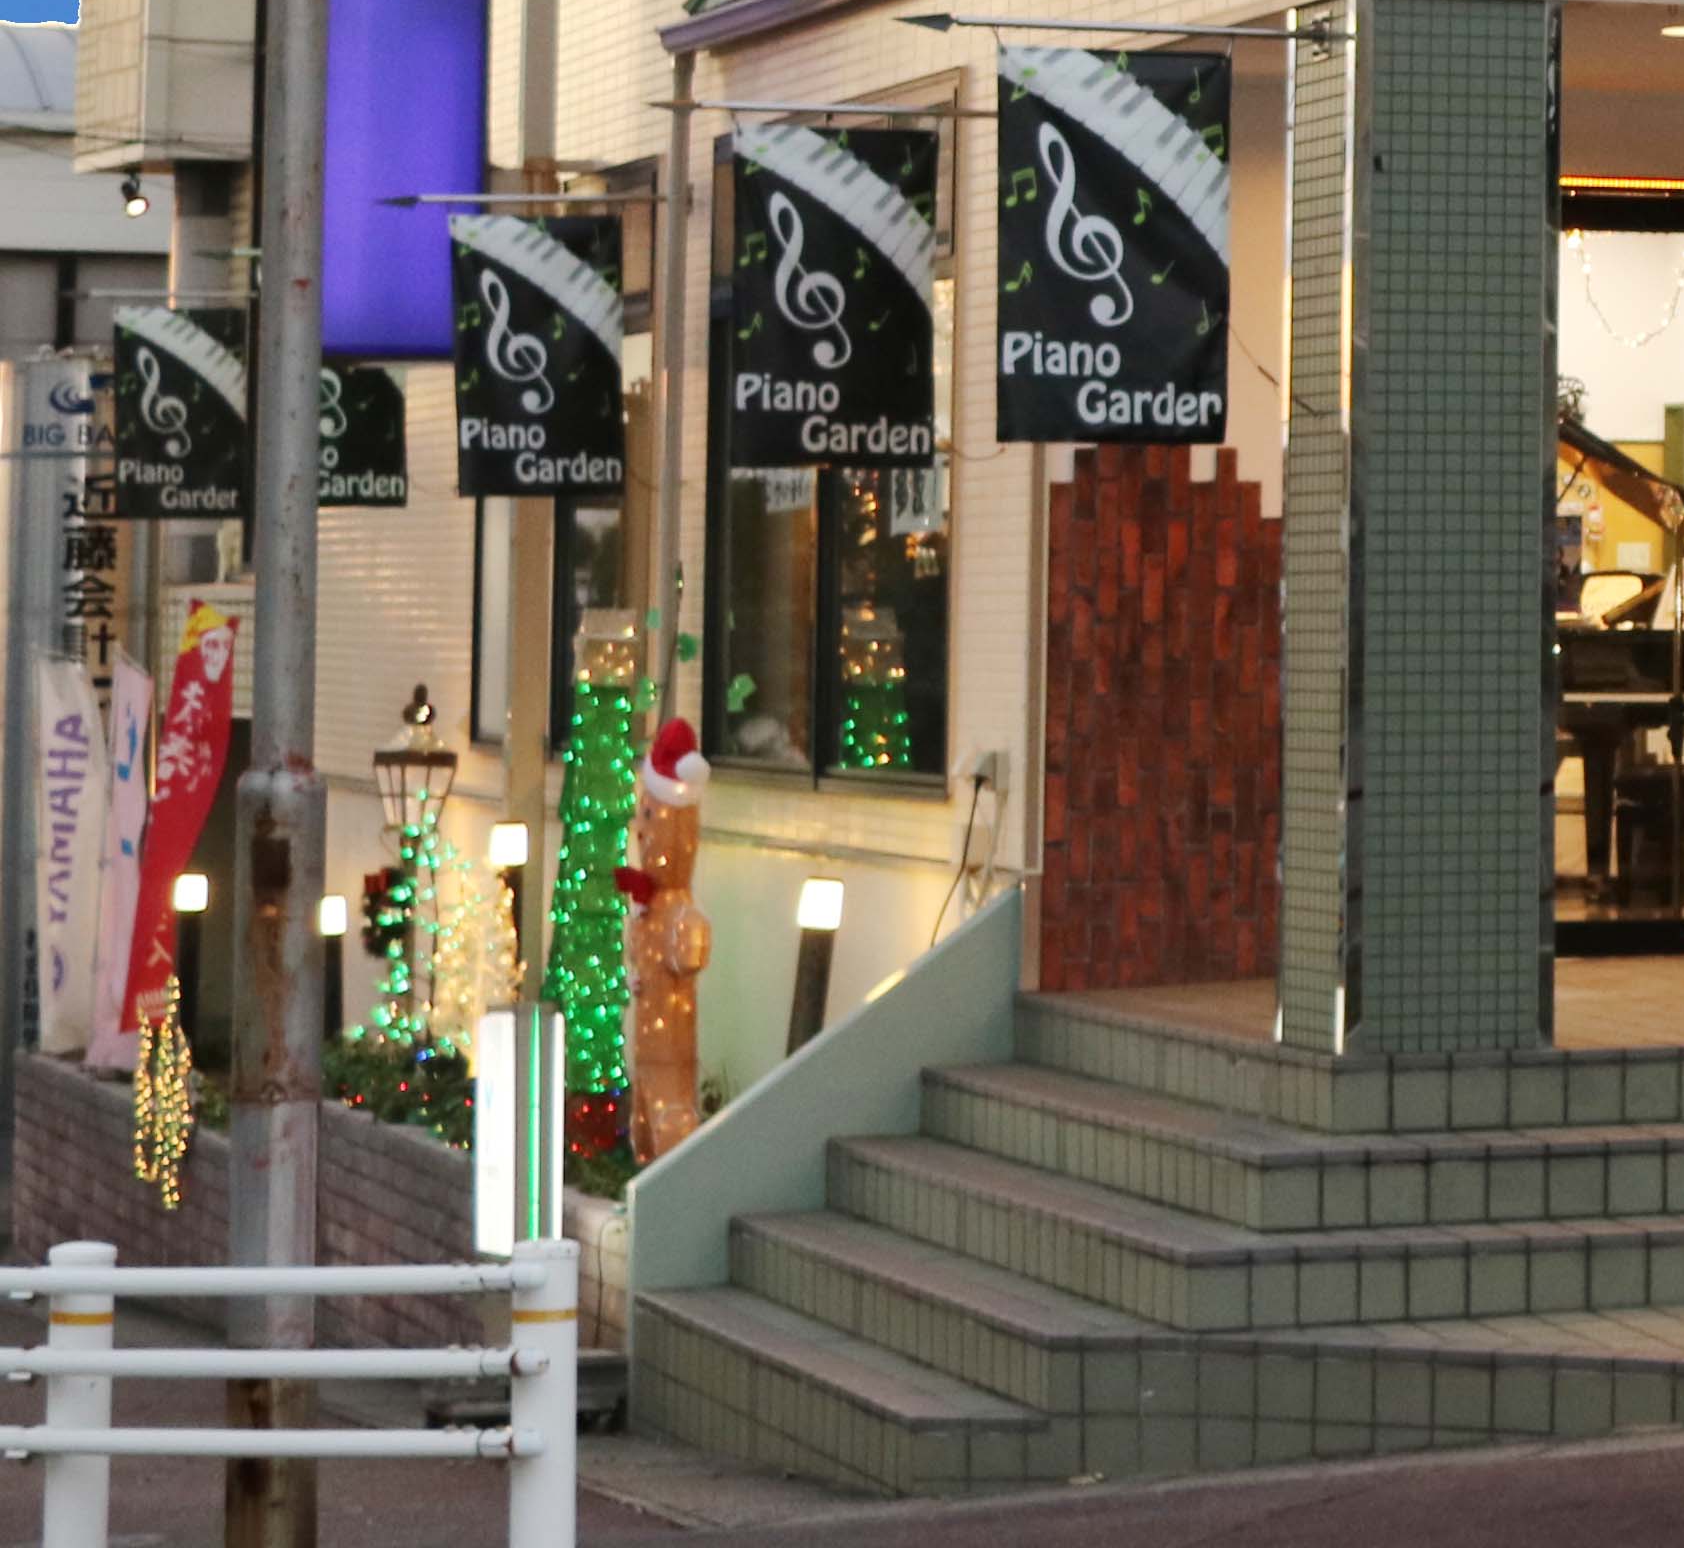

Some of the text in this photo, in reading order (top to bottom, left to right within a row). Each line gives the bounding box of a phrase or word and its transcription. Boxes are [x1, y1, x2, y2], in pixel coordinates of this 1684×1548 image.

[1002, 331, 1121, 378] Piano
[736, 372, 841, 412] Piano
[23, 423, 65, 448] BIG
[460, 417, 546, 450] Piano
[801, 414, 931, 455] Garden
[118, 458, 185, 485] Piano
[515, 448, 623, 484] Garden
[62, 472, 118, 700] 近藤会計
